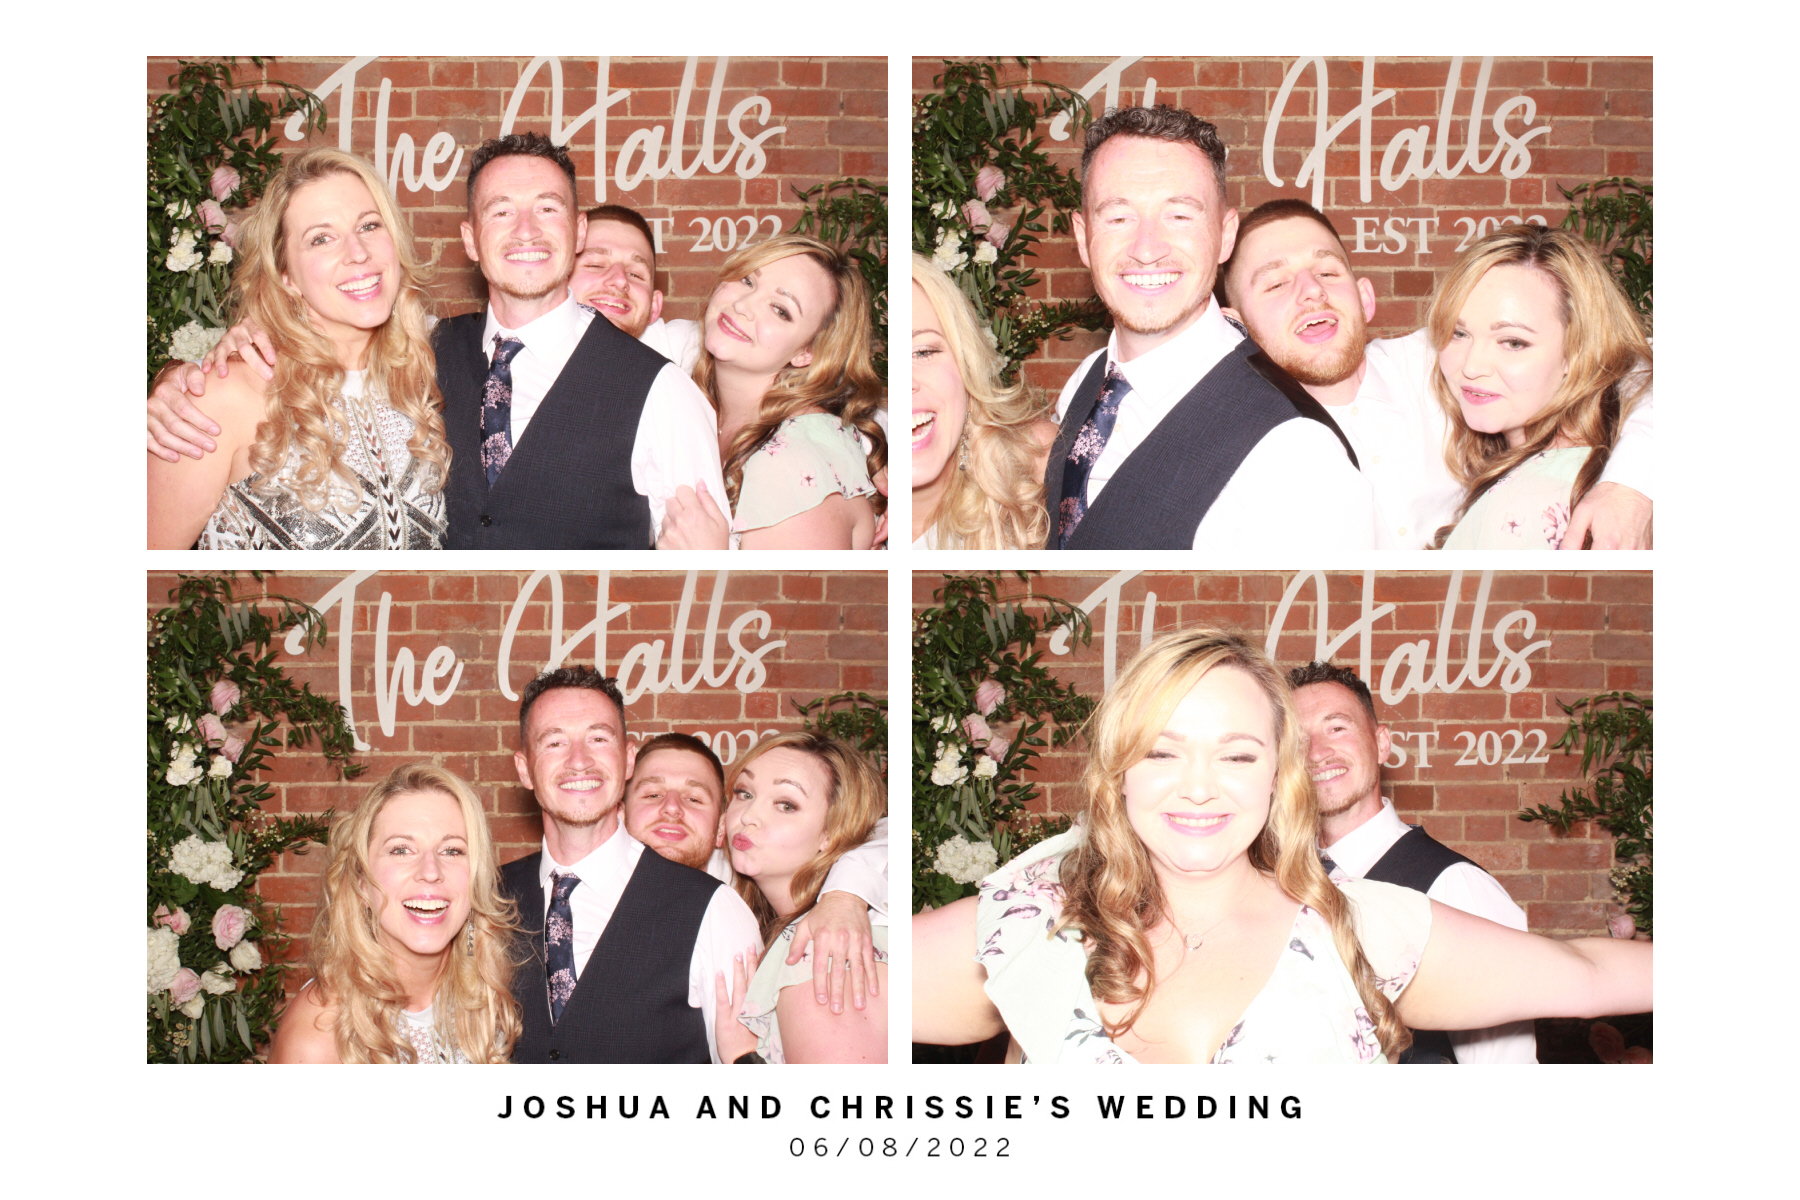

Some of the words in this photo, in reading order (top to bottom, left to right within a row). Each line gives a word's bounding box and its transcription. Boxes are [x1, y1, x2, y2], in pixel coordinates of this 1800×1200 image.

[284, 56, 464, 197] The
[501, 56, 786, 203] Halls
[1263, 56, 1552, 213] Halls
[1351, 216, 1440, 255] EST
[284, 569, 464, 752] The
[499, 569, 786, 706] Halls
[1265, 569, 1552, 706] Halls
[1383, 731, 1440, 769] ST
[1453, 729, 1550, 767] 2022
